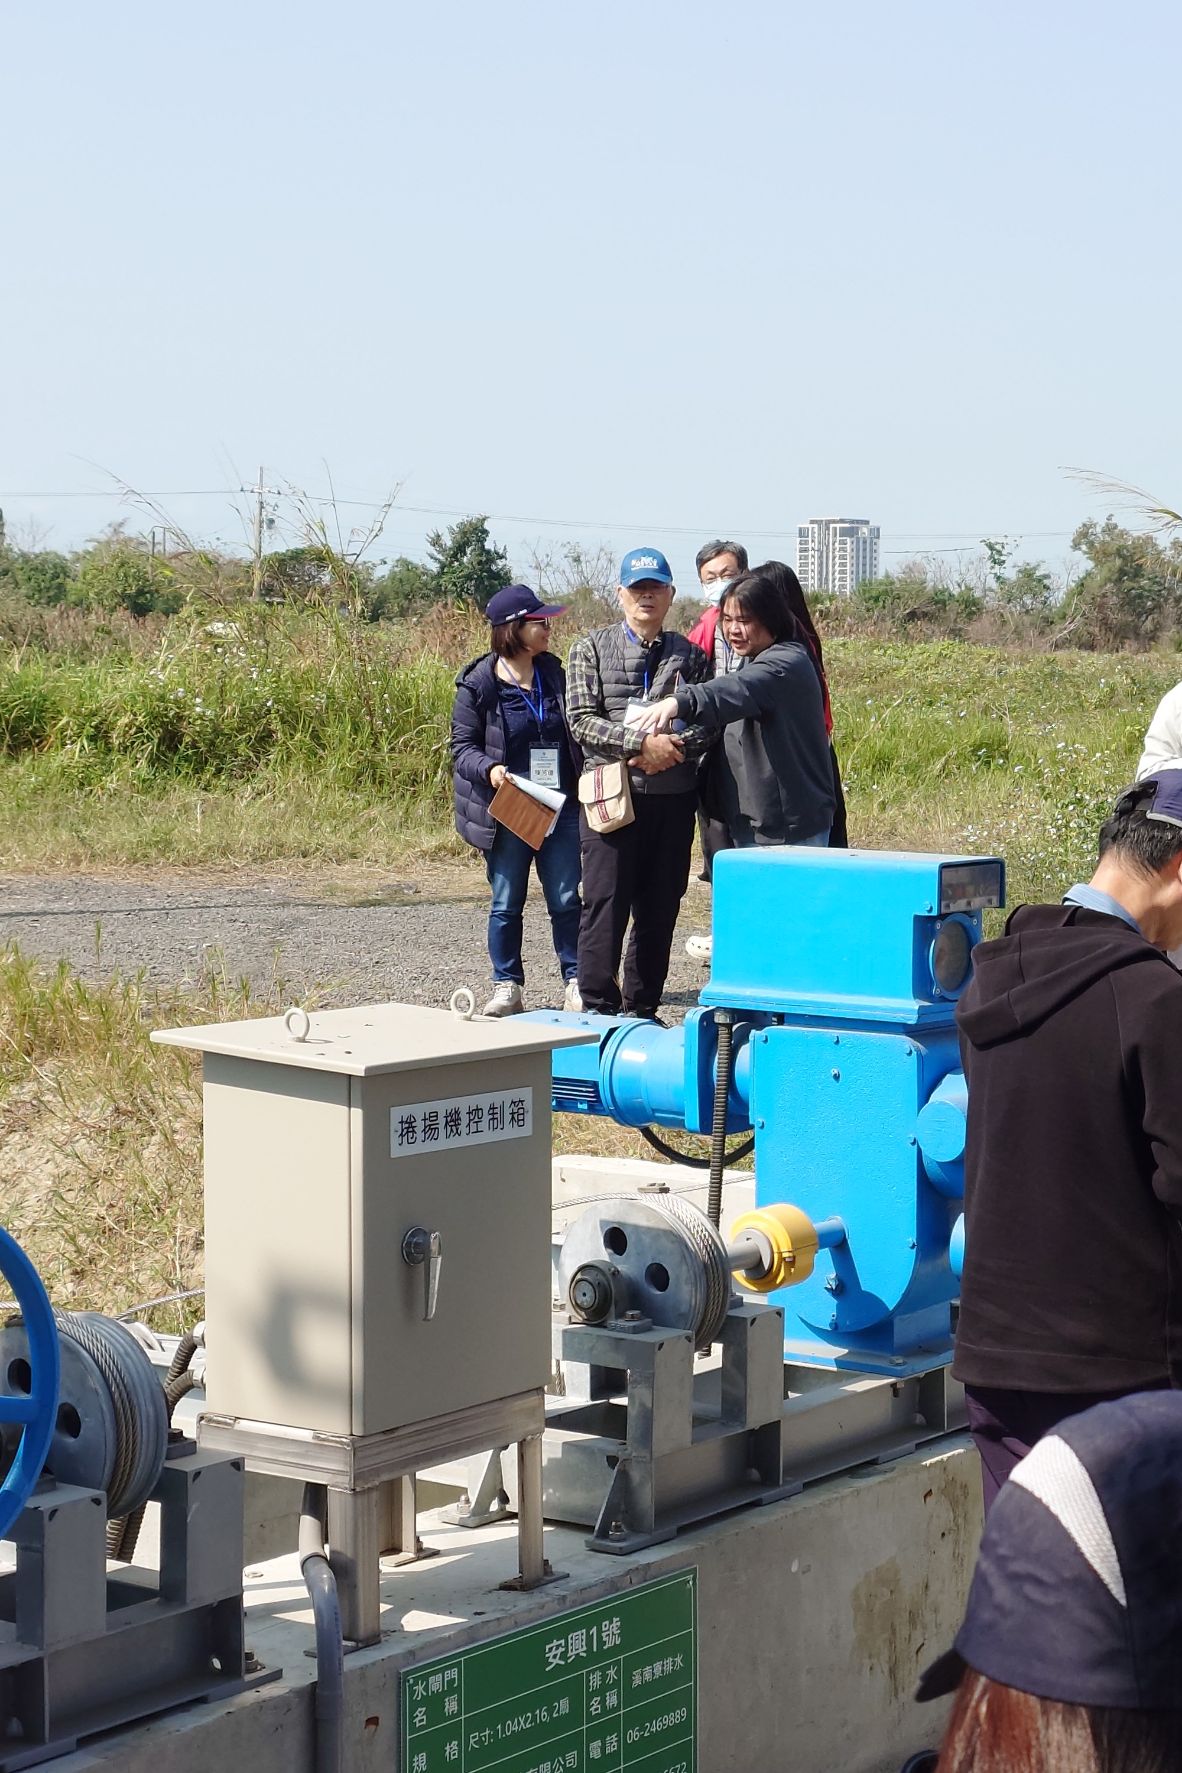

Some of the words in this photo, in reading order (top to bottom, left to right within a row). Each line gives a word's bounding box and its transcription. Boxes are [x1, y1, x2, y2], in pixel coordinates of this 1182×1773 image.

[397, 1097, 526, 1147] 捲揚機控制箱
[545, 1616, 621, 1671] 安興1號
[412, 1667, 458, 1701] 水閘門
[588, 1664, 618, 1692] 排水
[626, 1707, 687, 1744] 06-2469889
[589, 1732, 618, 1760] 電話
